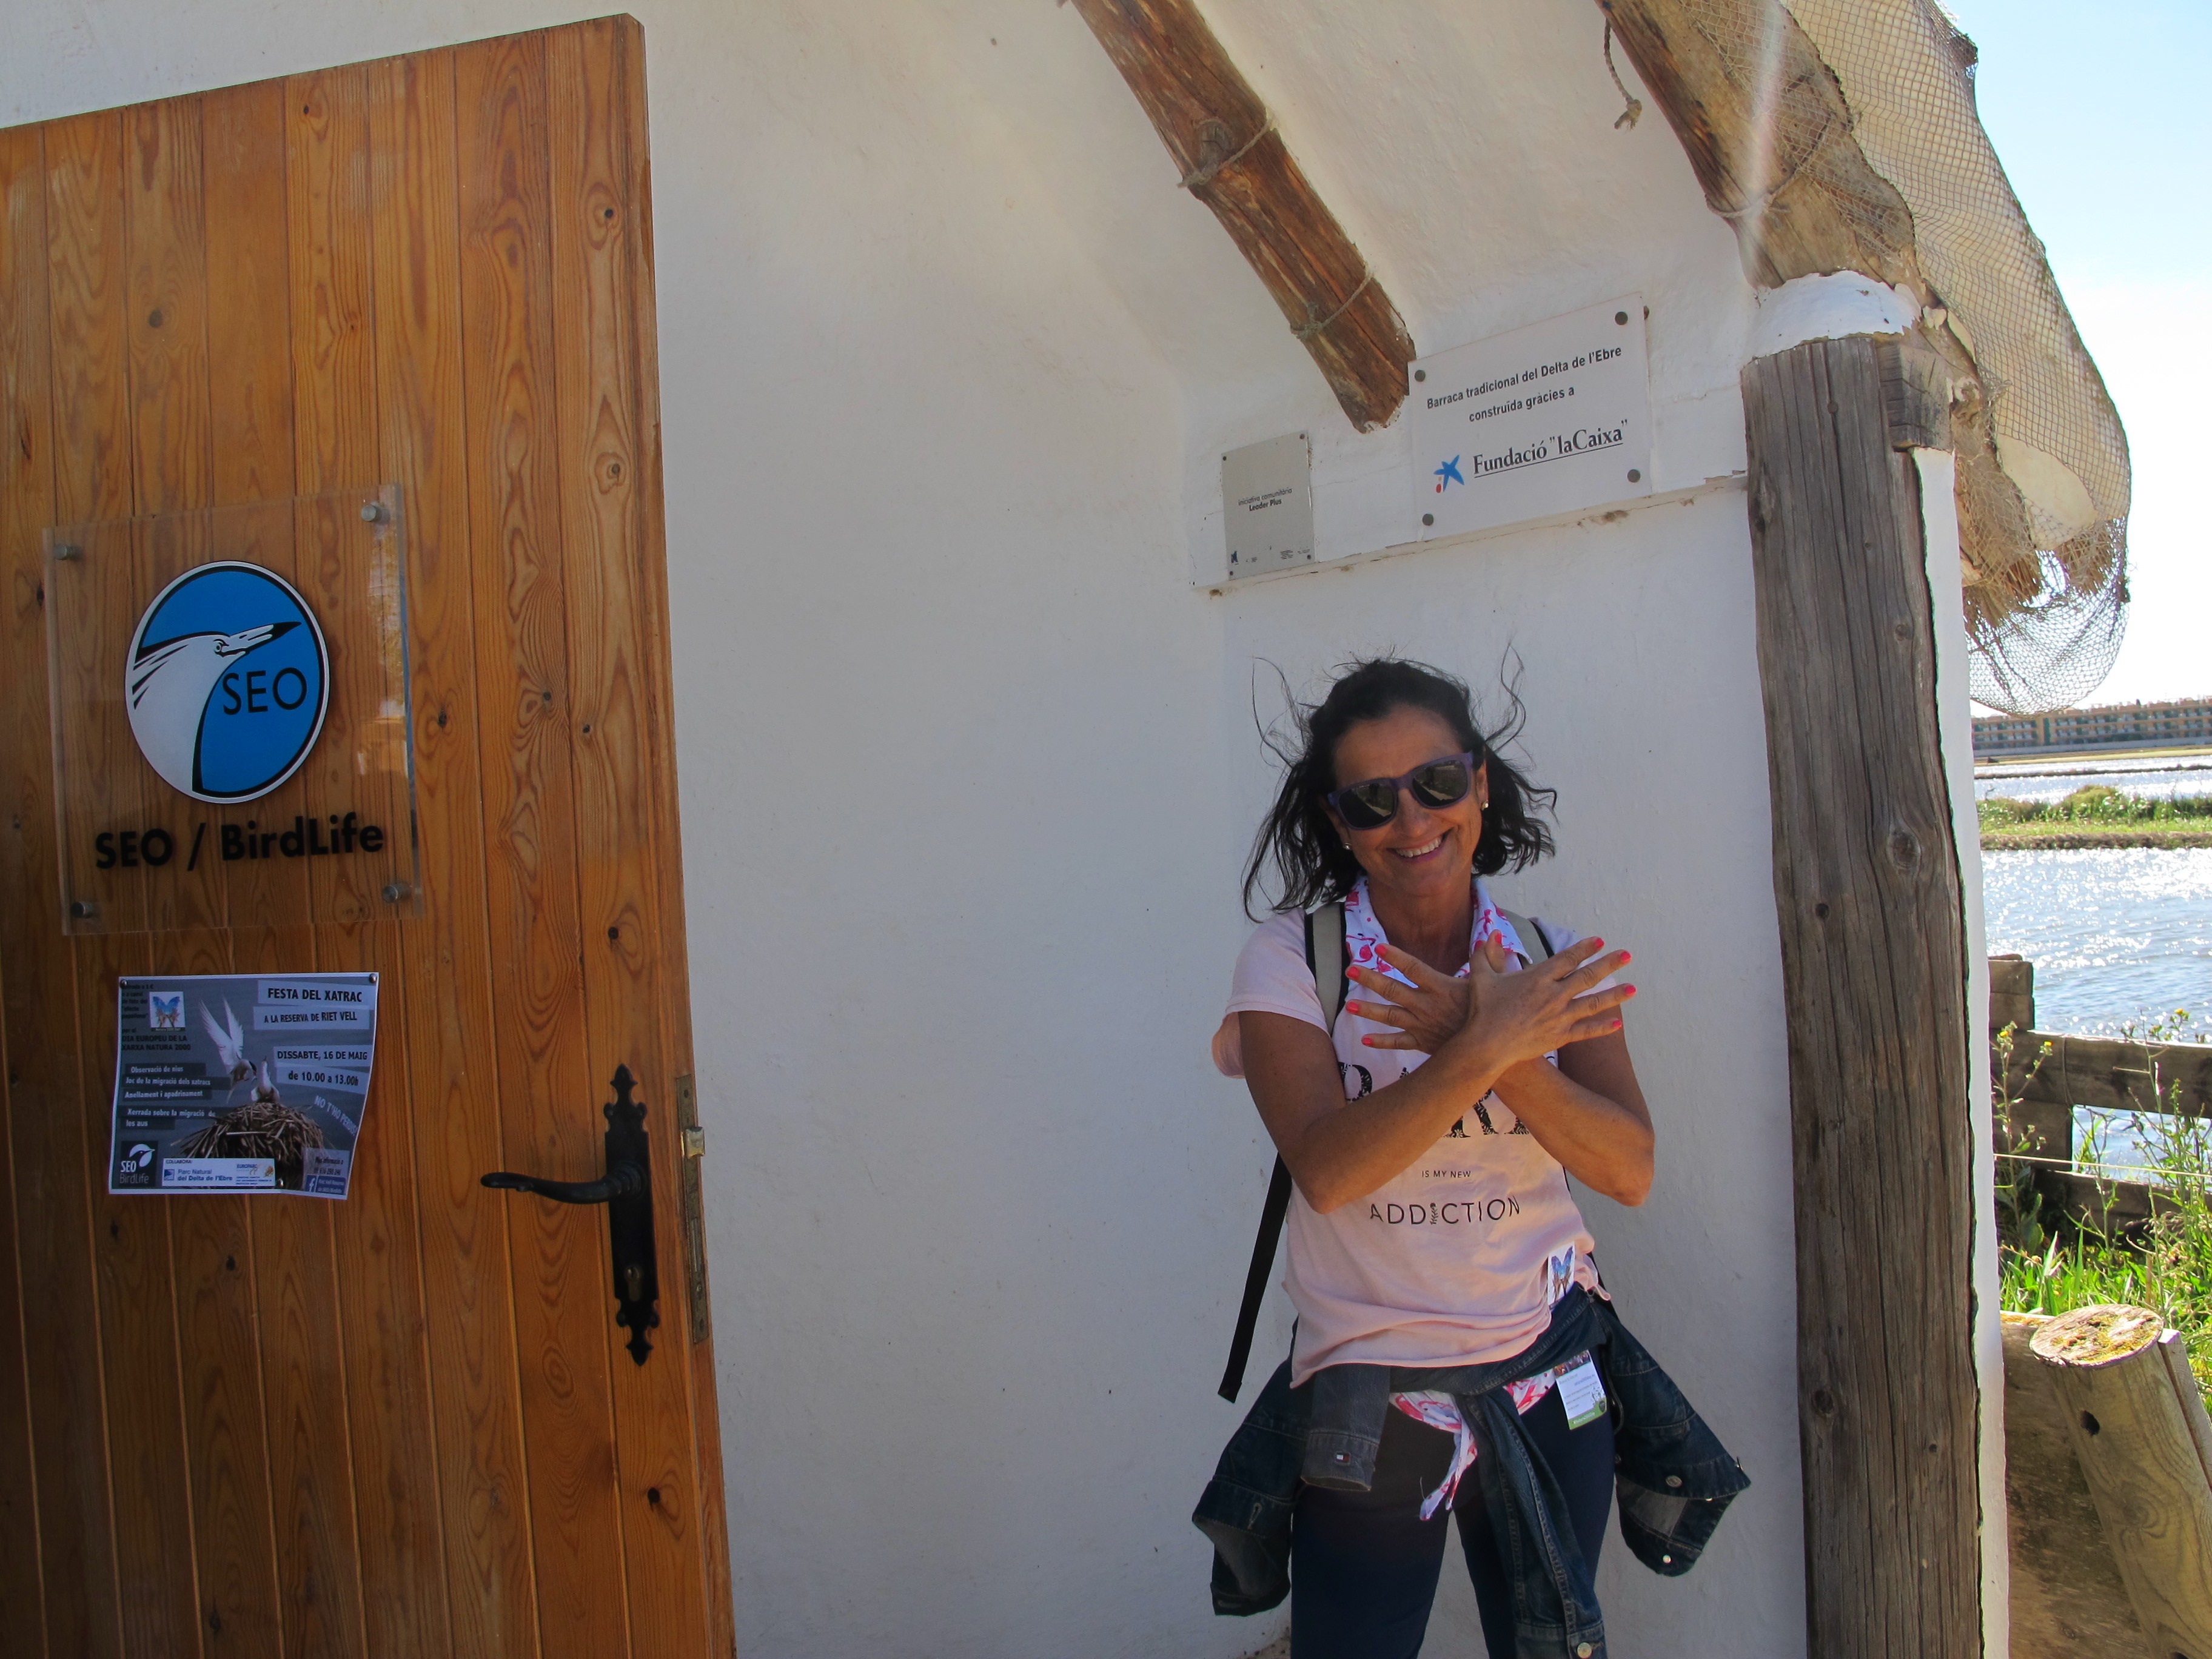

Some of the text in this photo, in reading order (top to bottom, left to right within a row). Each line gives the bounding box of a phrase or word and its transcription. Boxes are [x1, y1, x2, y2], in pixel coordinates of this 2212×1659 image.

[1427, 346, 1622, 409] Barraca tradicional del Delta de l'Ebre
[1469, 386, 1575, 422] construïda gràcies a
[1473, 439, 1547, 475] Fundació
[1249, 501, 1269, 511] Leader
[222, 667, 307, 716] SEO
[95, 812, 384, 871] SEO / BirdLife
[268, 988, 363, 1002] FESTA DEL XATRAC
[271, 1014, 279, 1023] LA
[280, 1013, 309, 1023] RESERVA
[321, 1011, 337, 1021] RIET
[340, 1011, 357, 1021] VELL
[277, 1051, 321, 1061] DISSABTE,
[324, 1051, 333, 1059] 16
[348, 1051, 367, 1060] MAIG
[288, 1070, 298, 1080] de
[301, 1071, 325, 1082] 10.00
[335, 1074, 358, 1086] 13.00h
[314, 1095, 326, 1108] NO
[179, 1110, 205, 1118] migració
[120, 1161, 136, 1173] SEO
[119, 1173, 149, 1184] BirdLife
[1450, 1170, 1471, 1178] NEW
